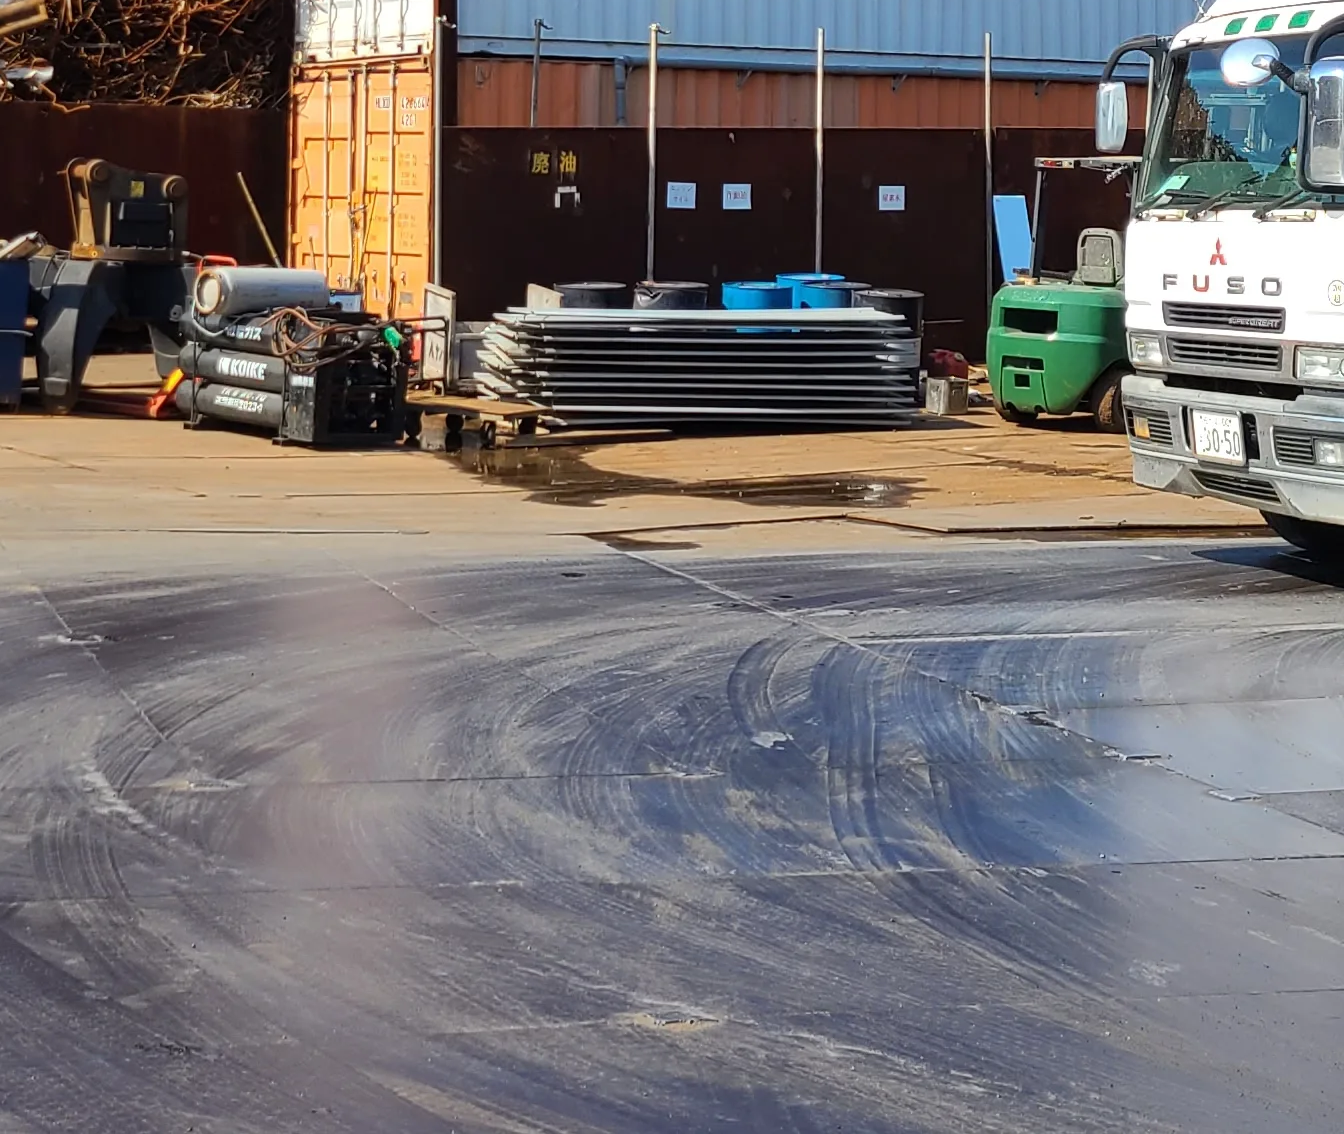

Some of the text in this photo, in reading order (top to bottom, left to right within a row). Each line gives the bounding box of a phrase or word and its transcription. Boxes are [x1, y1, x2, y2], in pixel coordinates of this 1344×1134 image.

[531, 150, 577, 174] 廃油
[1162, 273, 1283, 297] FUSO
[230, 359, 267, 380] KOIKE
